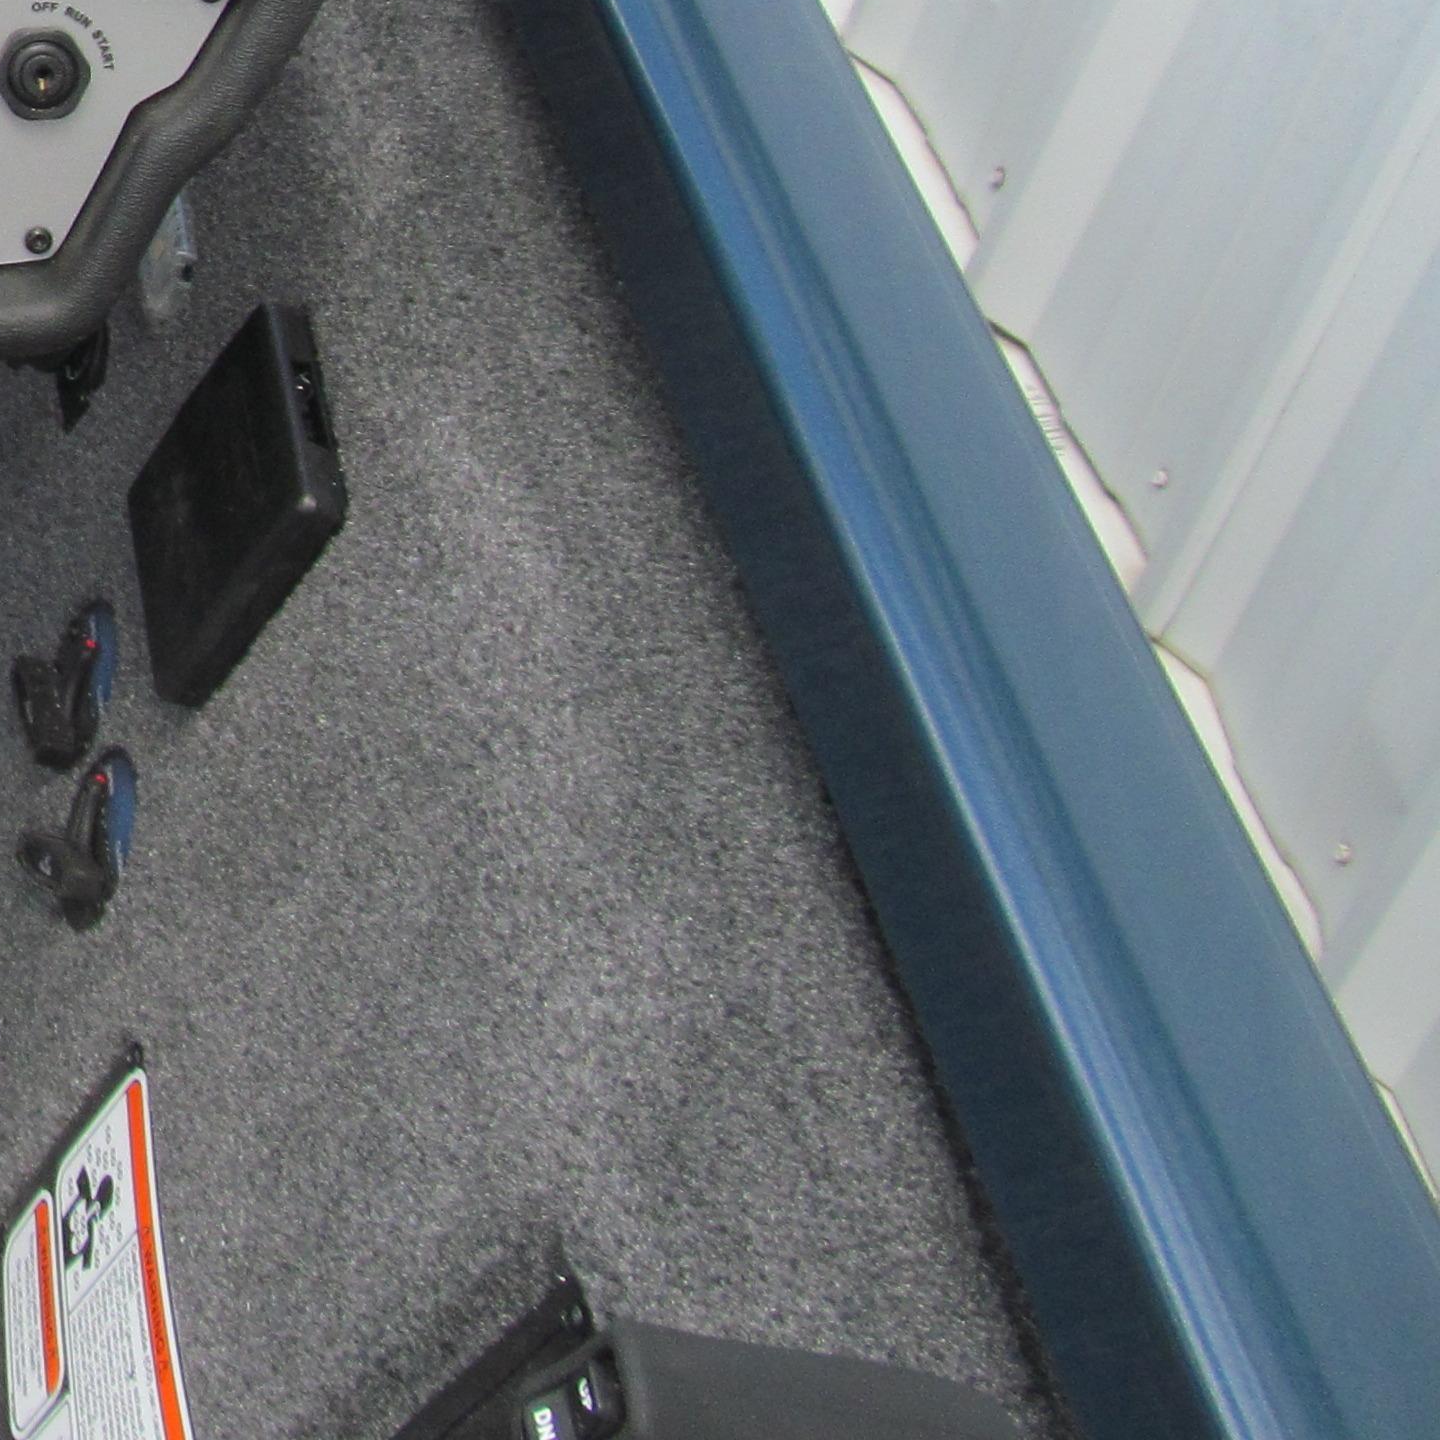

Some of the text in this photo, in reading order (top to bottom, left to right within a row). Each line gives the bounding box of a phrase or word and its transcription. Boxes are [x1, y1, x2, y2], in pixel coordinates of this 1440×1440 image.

[31, 1, 115, 71] OFF RUN START
